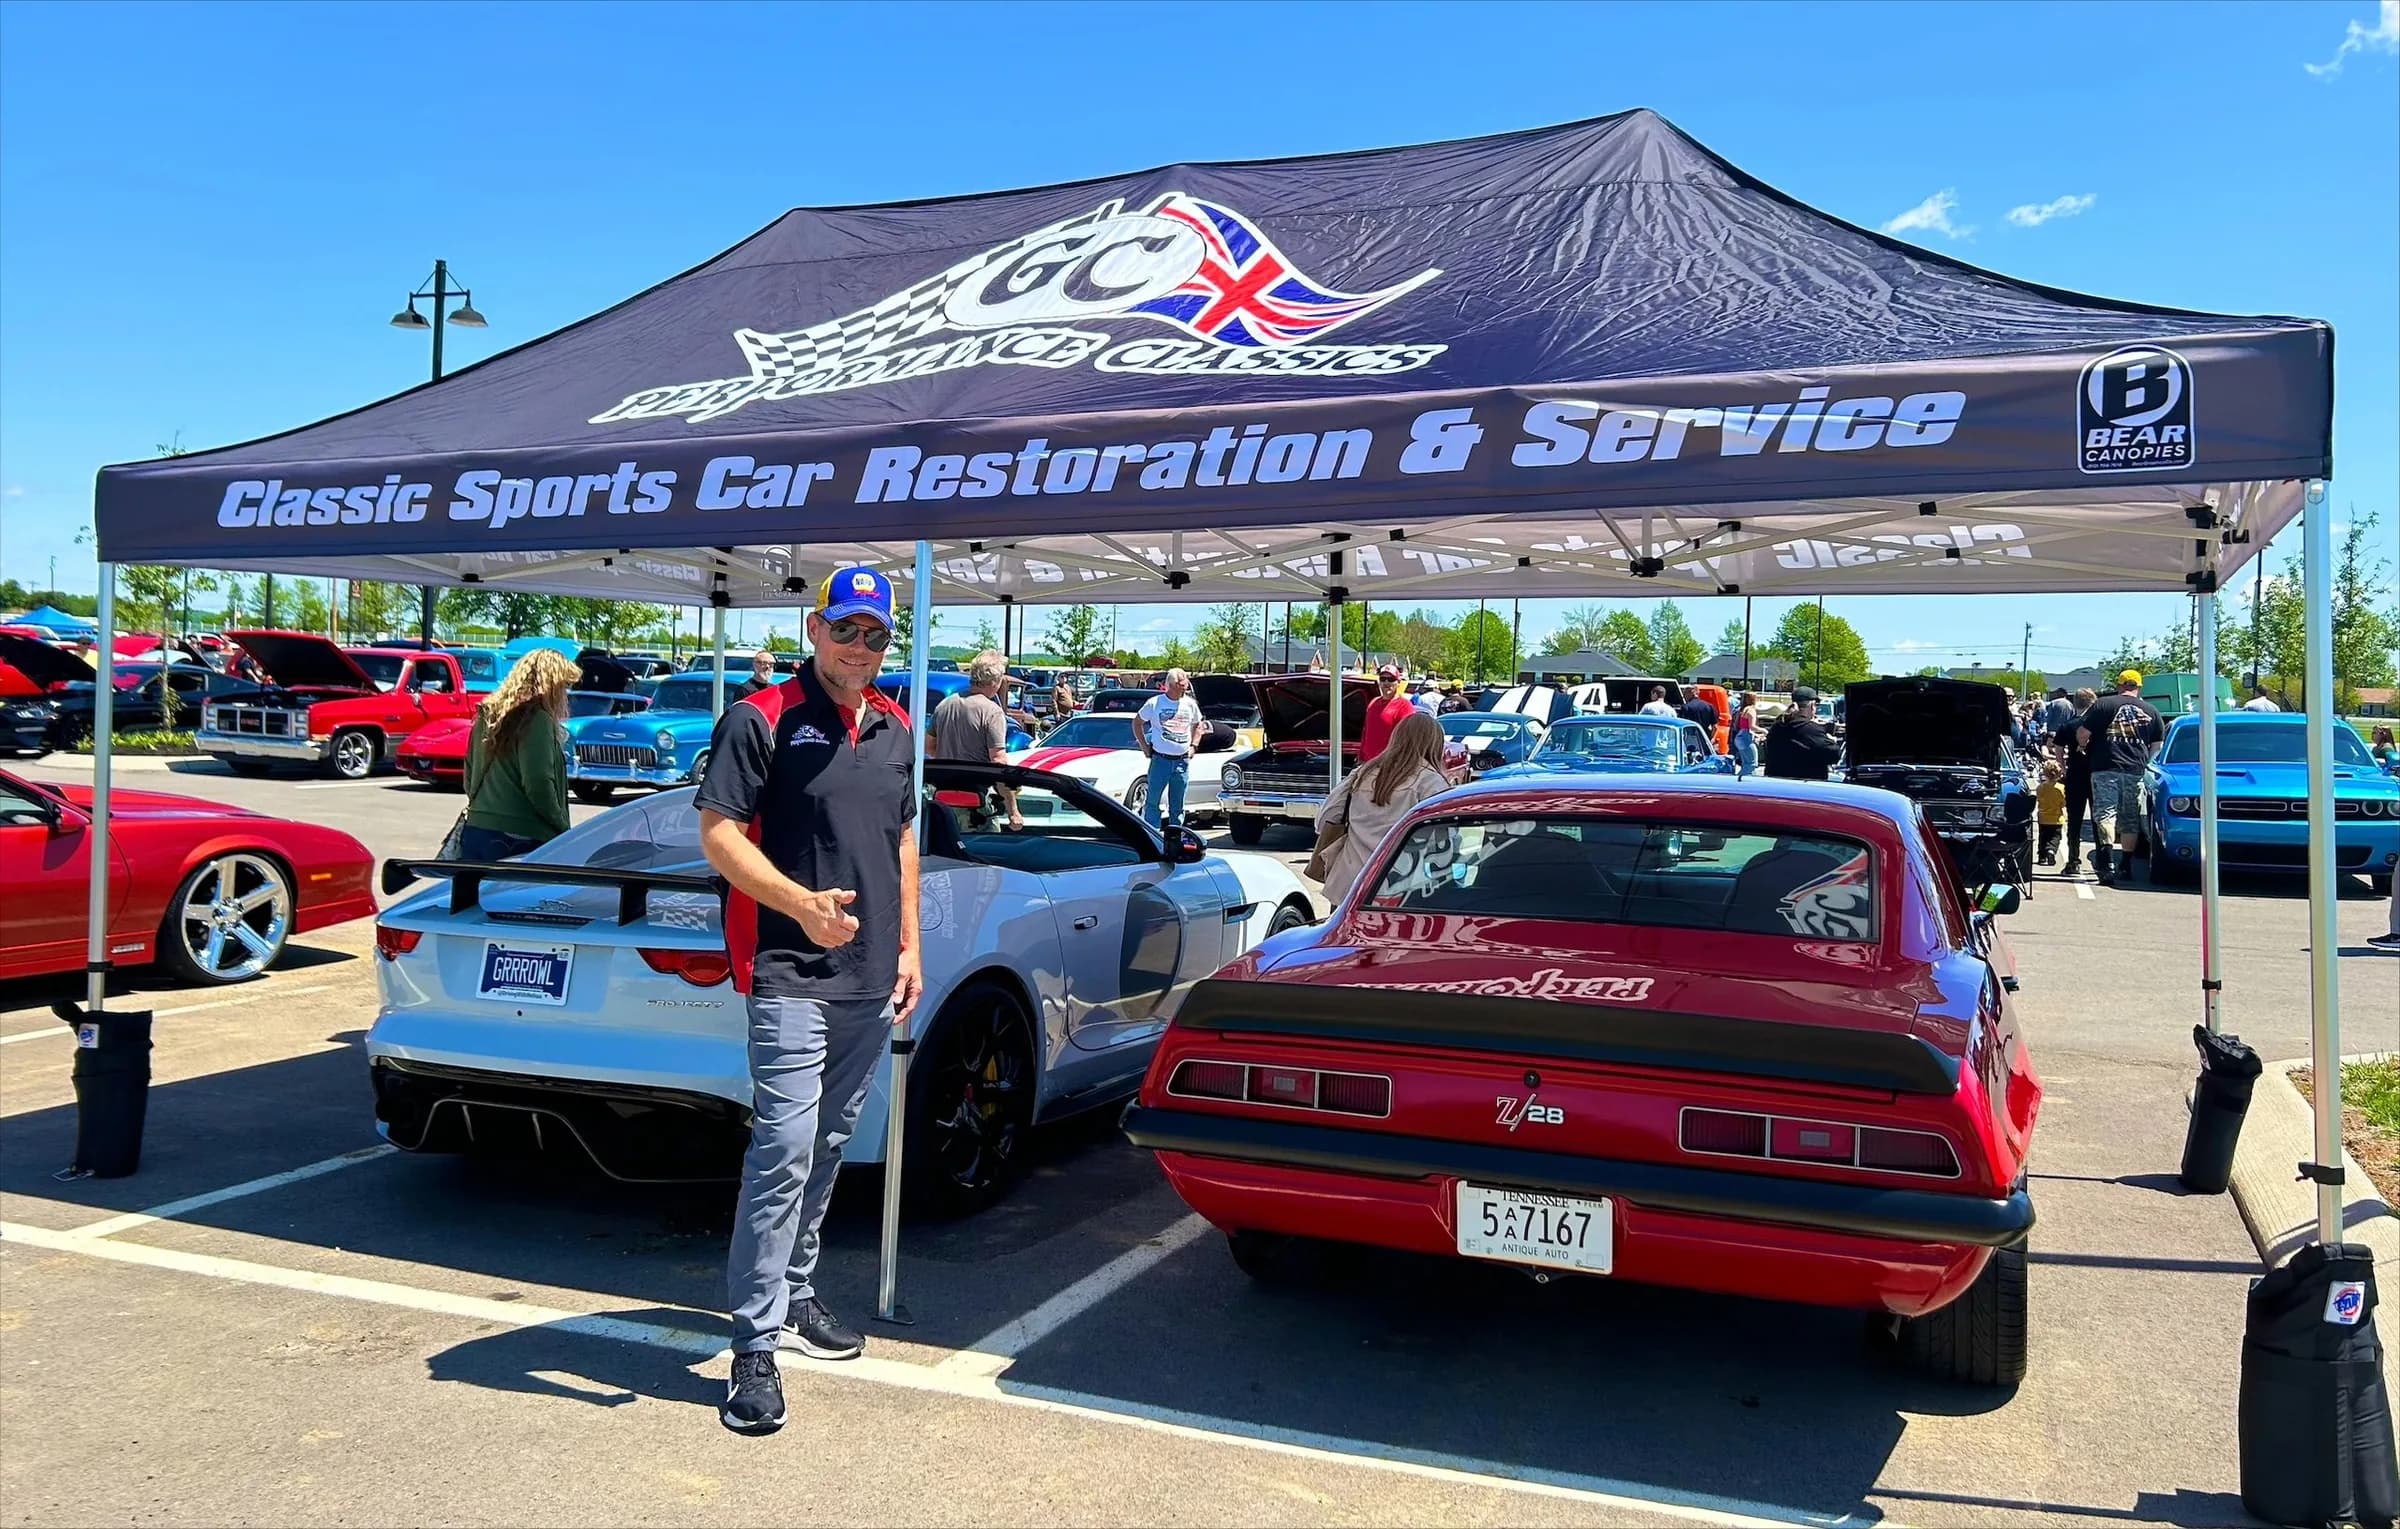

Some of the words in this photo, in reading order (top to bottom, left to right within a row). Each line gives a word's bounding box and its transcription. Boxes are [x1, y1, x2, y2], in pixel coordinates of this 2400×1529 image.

[978, 229, 1181, 307] GC
[588, 328, 1110, 423] PERFORMANCE
[1094, 338, 1449, 376] CLASSICS
[2085, 424, 2186, 449] BEAR
[217, 473, 433, 528] Classic
[448, 461, 678, 529] Sports
[695, 455, 834, 510] Car
[854, 422, 1373, 504] Restoration
[1398, 407, 1484, 474] &
[1511, 385, 1966, 468] Service
[2085, 444, 2186, 462] CANOPIES
[493, 956, 554, 985] GRRROWL
[1496, 1093, 1565, 1132] Z/28
[1502, 1190, 1569, 1208] TENNESSEE
[1502, 1243, 1538, 1257] ANTIQUE
[1545, 1248, 1569, 1260] AUTO
